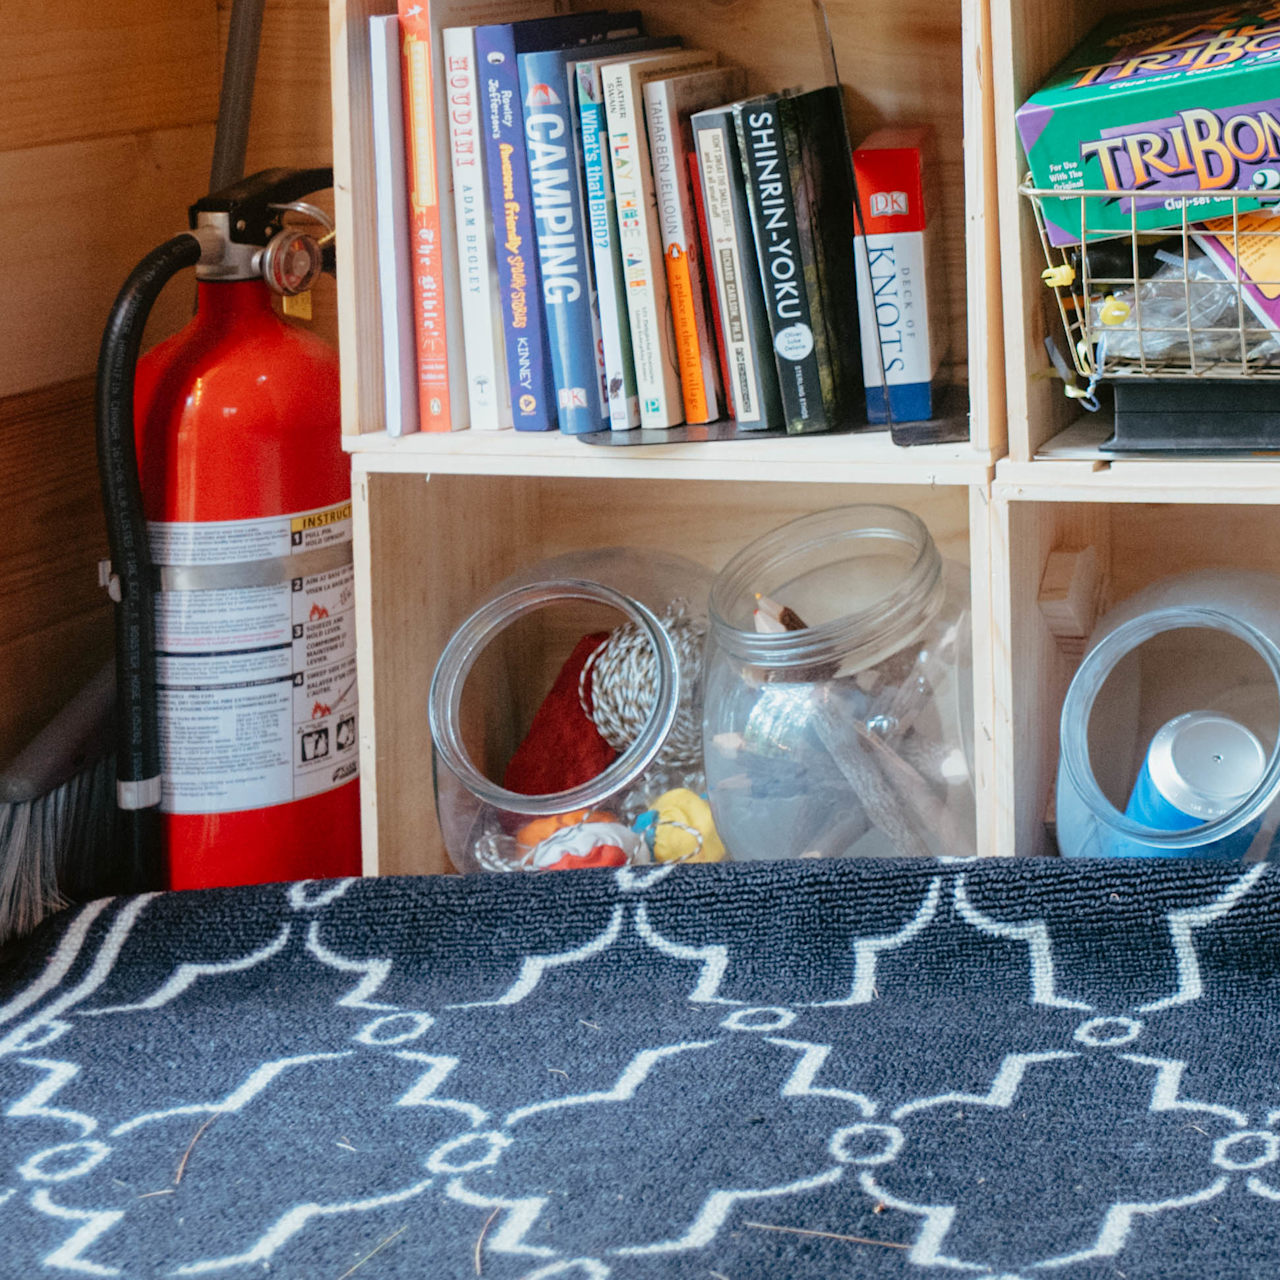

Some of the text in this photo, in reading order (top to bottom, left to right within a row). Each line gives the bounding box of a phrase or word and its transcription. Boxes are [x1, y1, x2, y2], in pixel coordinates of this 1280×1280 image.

[448, 56, 475, 167] HOUDINI
[487, 79, 501, 140] Jefferson's
[501, 90, 513, 128] Rowley
[607, 83, 616, 114] SWAIN
[616, 76, 627, 119] HEATHER
[581, 109, 610, 249] What's that BIRD?
[612, 132, 633, 181] PLAY
[651, 100, 678, 234] TAHAR BEN JELLOUN
[1049, 170, 1083, 183] With The
[1050, 161, 1078, 172] For Use
[504, 201, 524, 254] Friendly
[525, 113, 581, 304] CAMPING
[749, 112, 802, 318] SHINRIN-YOKU
[874, 195, 904, 212] DK
[462, 185, 480, 294] ADAM BEGLEY
[674, 281, 686, 316] palace
[679, 316, 688, 329] in
[867, 245, 905, 373] KNOTS
[901, 267, 915, 339] DECK OF
[517, 336, 533, 390] KINNEY
[681, 330, 690, 347] the
[685, 348, 693, 368] old
[687, 374, 700, 410] village
